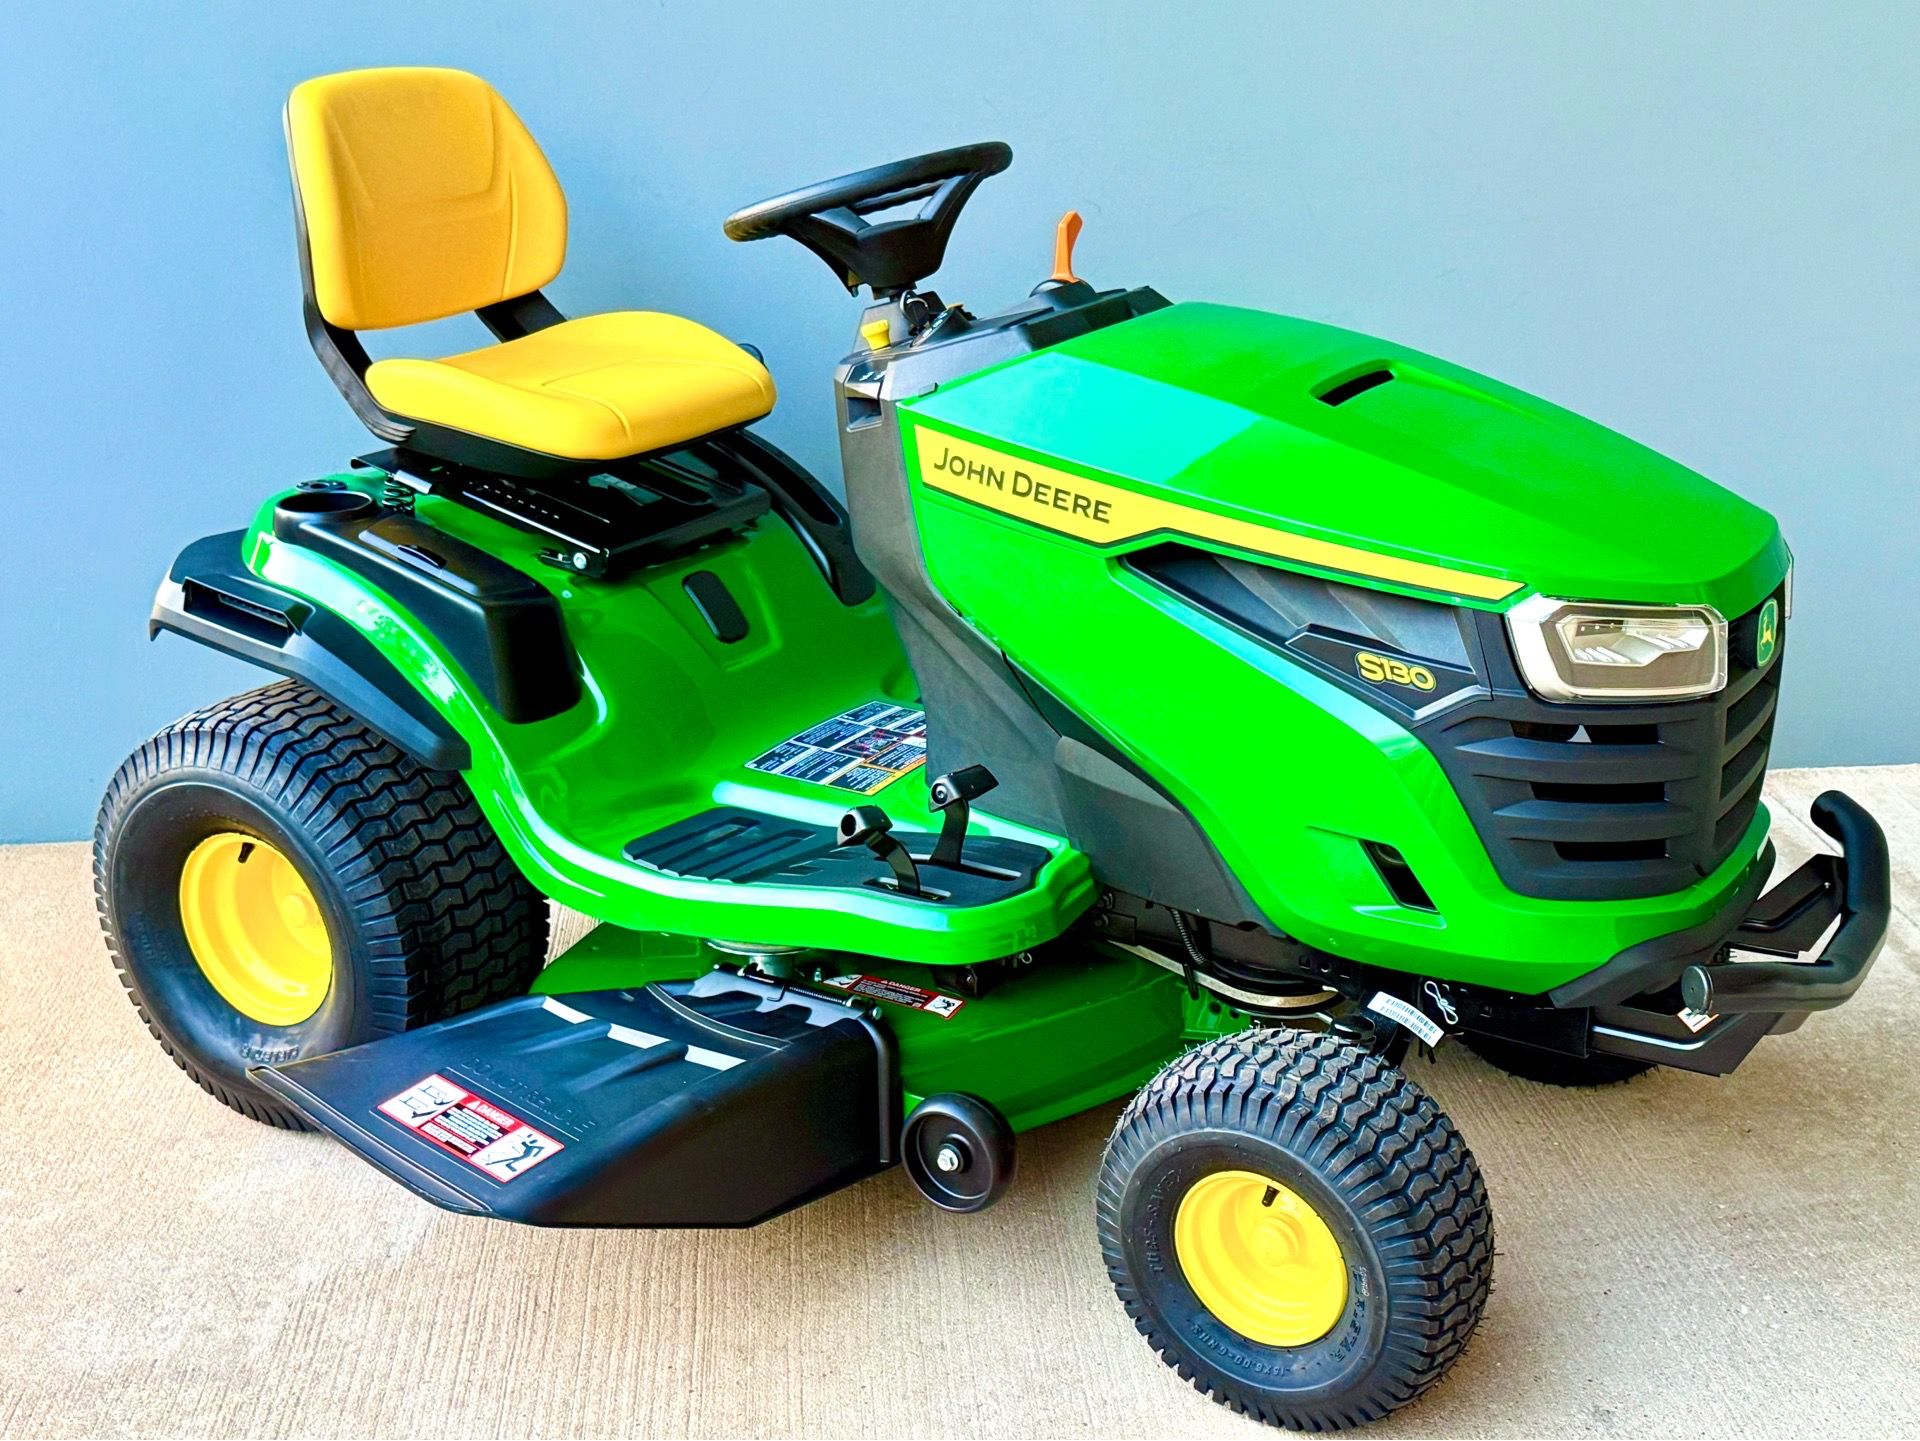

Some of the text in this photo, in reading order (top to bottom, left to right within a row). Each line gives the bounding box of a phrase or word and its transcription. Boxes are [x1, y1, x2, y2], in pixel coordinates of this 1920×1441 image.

[933, 447, 1112, 524] JOHN DEERE
[1356, 652, 1436, 691] S130
[888, 981, 921, 992] DANGER
[476, 1103, 516, 1128] DANGER
